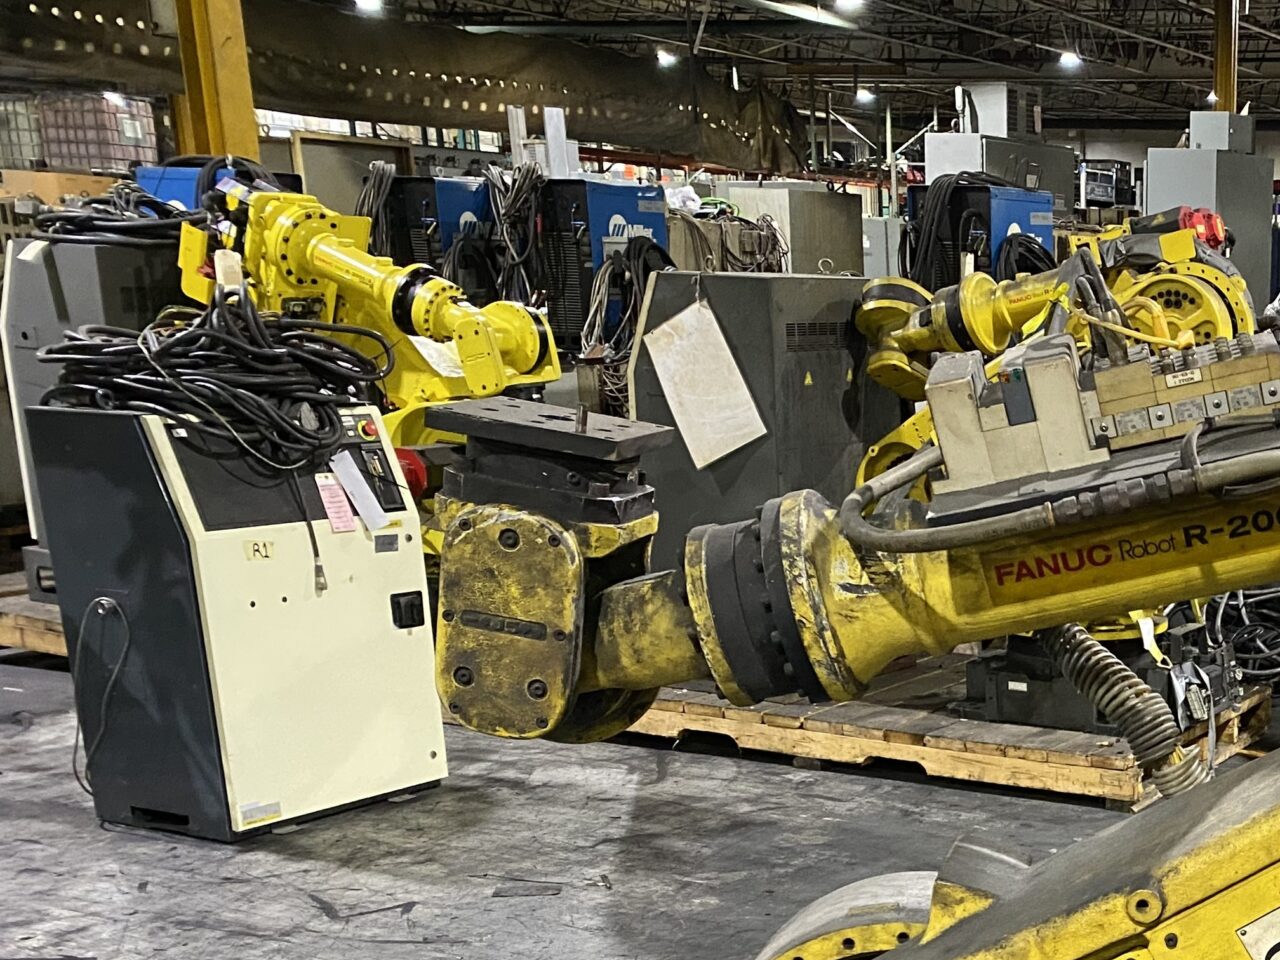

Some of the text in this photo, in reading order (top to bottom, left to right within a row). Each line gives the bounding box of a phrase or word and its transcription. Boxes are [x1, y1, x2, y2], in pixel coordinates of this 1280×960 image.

[253, 542, 270, 558] R1
[994, 544, 1112, 586] FANUC
[1118, 535, 1177, 562] Robot
